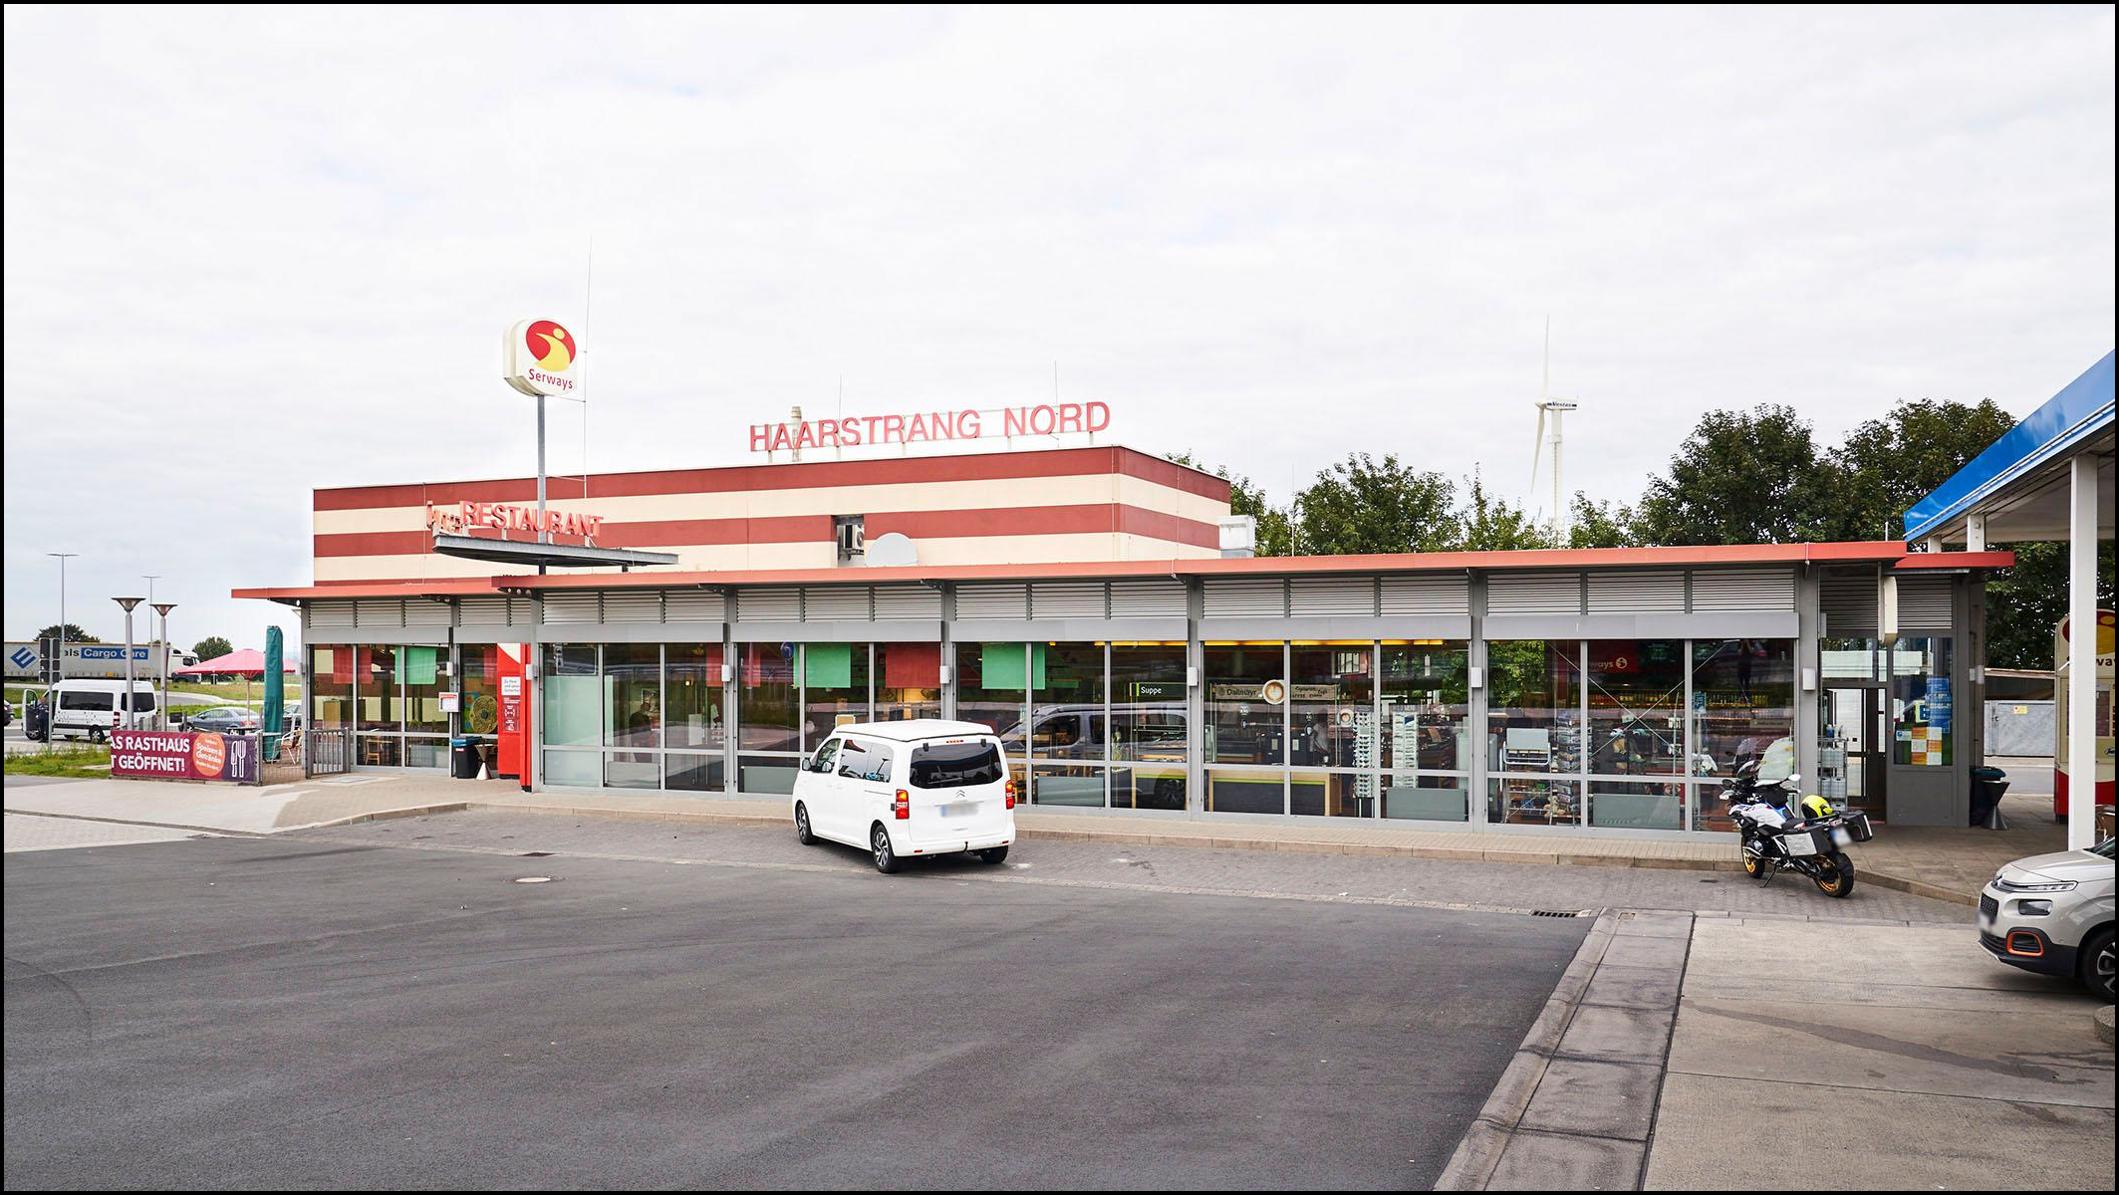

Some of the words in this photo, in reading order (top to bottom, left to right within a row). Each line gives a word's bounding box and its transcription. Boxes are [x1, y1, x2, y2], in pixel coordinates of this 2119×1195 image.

[528, 368, 574, 391] Serways
[749, 409, 982, 453] HAARSTRANG
[1003, 401, 1111, 438] NORD
[459, 500, 605, 538] RESTAURANT
[84, 649, 117, 659] Cargo
[120, 649, 146, 658] Cre
[1140, 686, 1162, 695] Suppe
[111, 735, 123, 750] AS
[126, 736, 190, 753] RASTHAUS
[111, 755, 118, 768] T
[119, 752, 185, 772] GEÖFFNET!
